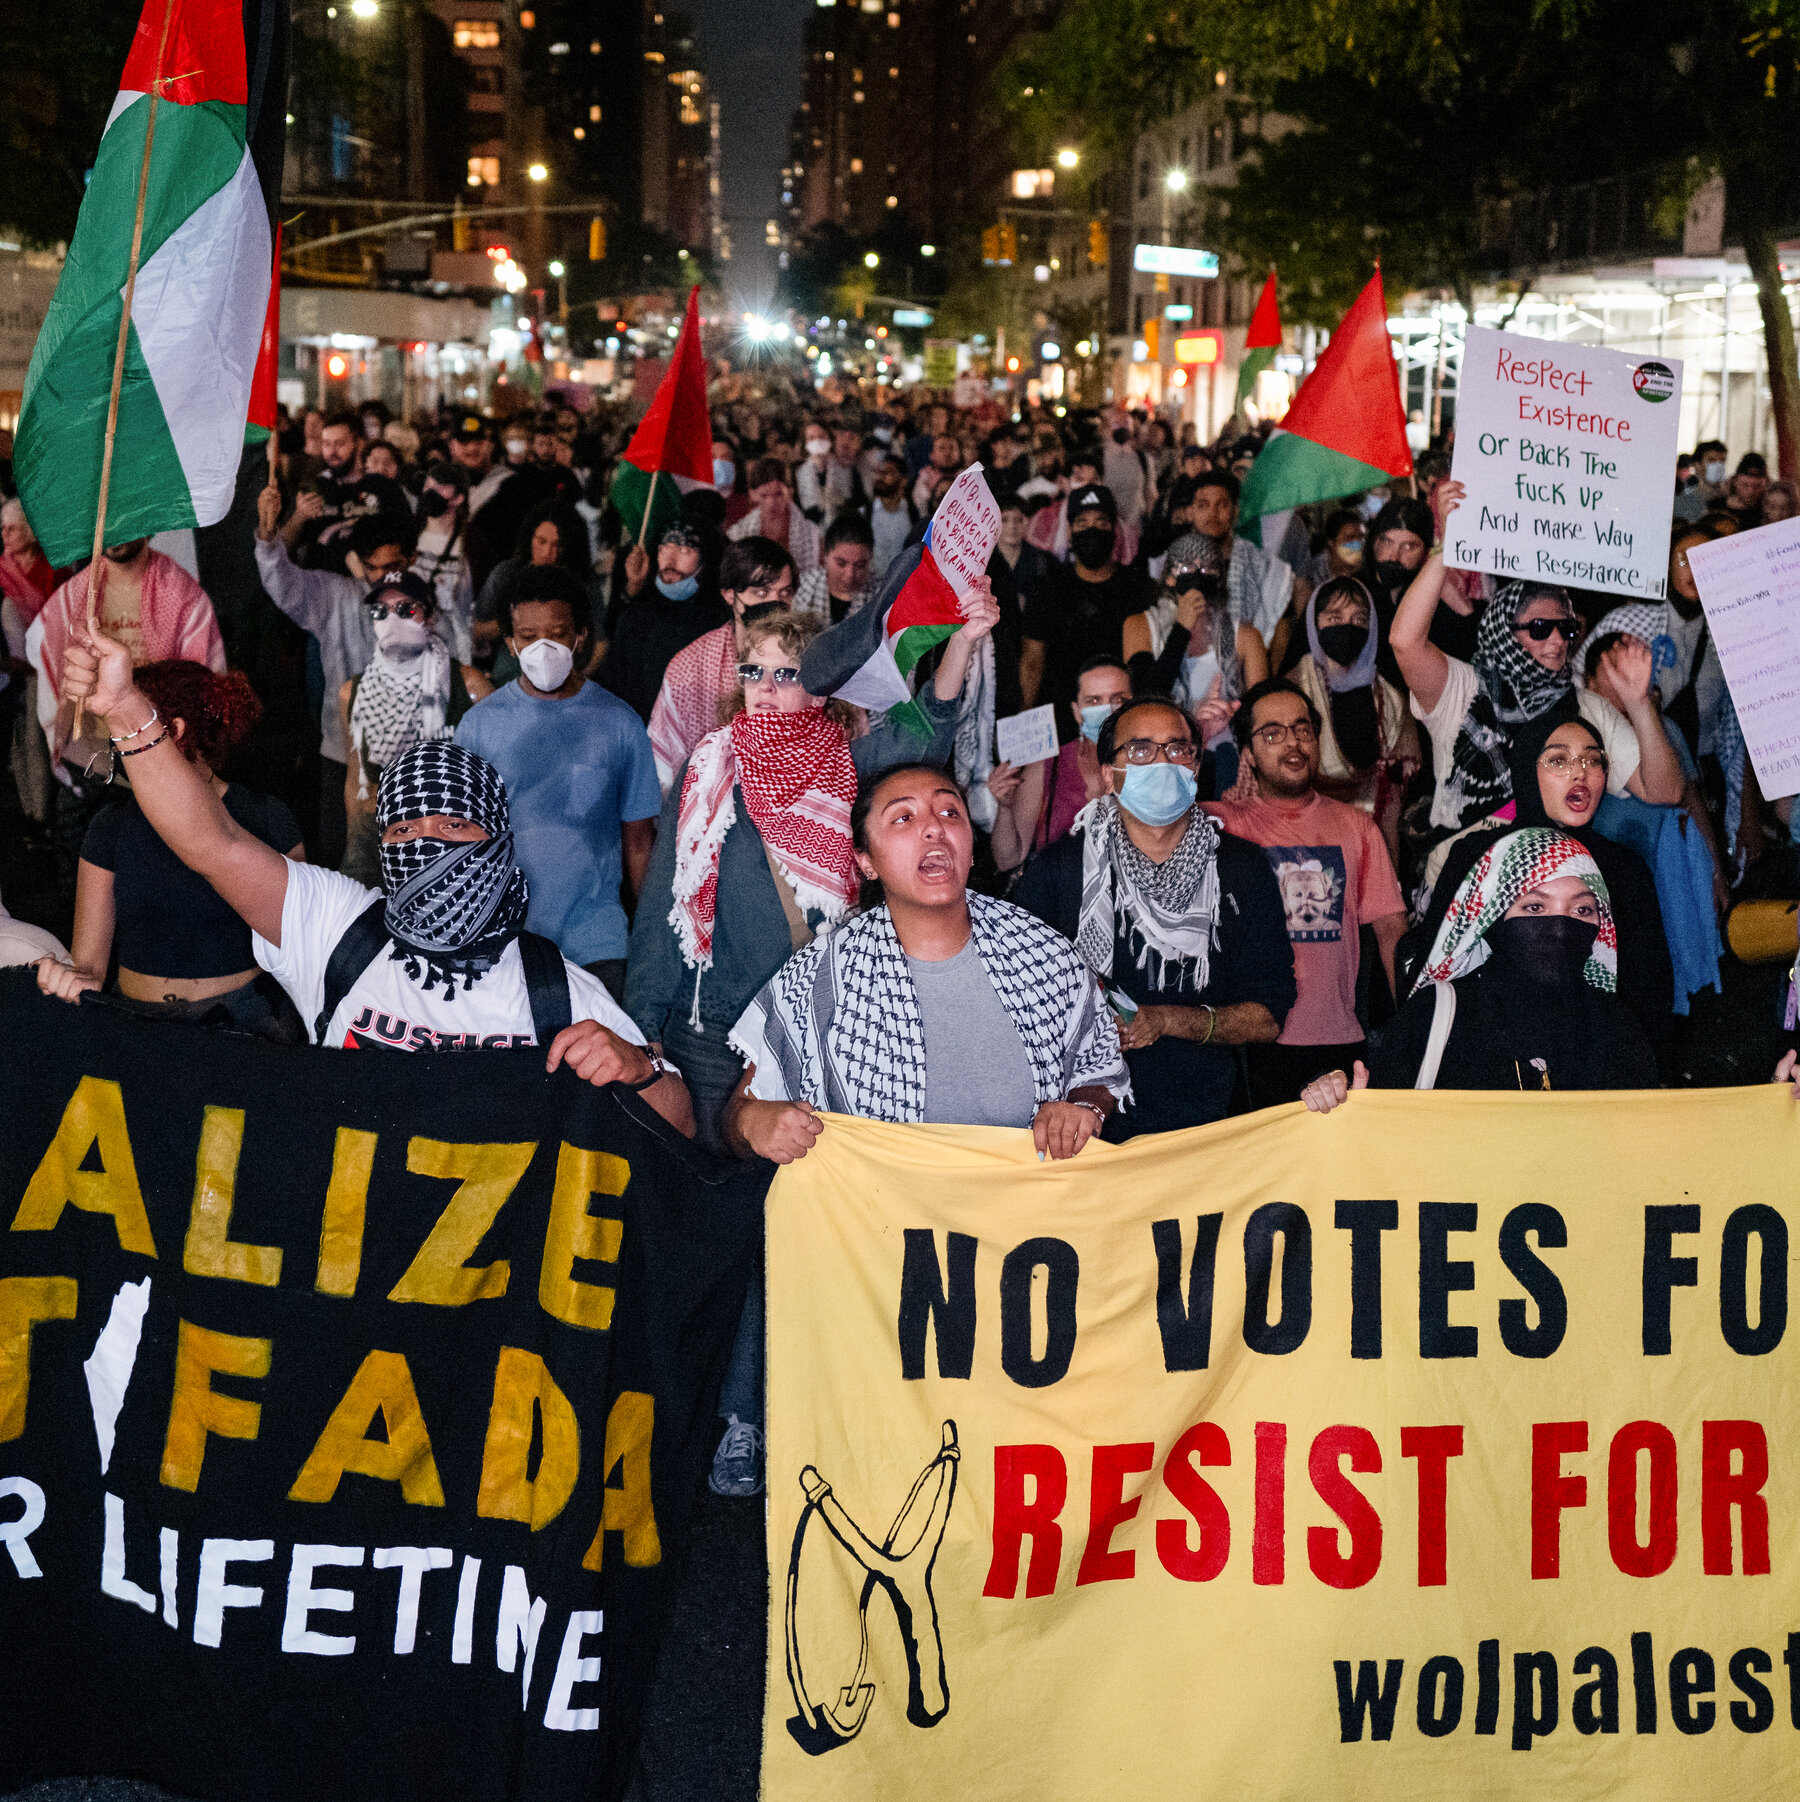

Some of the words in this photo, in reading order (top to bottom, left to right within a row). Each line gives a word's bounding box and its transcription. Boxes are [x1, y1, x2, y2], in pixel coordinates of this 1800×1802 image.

[1479, 506, 1519, 533] And
[1594, 519, 1633, 559] Way
[1580, 450, 1619, 479] The
[10, 1075, 632, 1330] ALIZE
[897, 1227, 1079, 1388] NO
[1151, 1199, 1568, 1373] VOTES
[1642, 1202, 1789, 1357] FO
[982, 1421, 1465, 1600] RESIST
[1531, 1419, 1771, 1581] FOR
